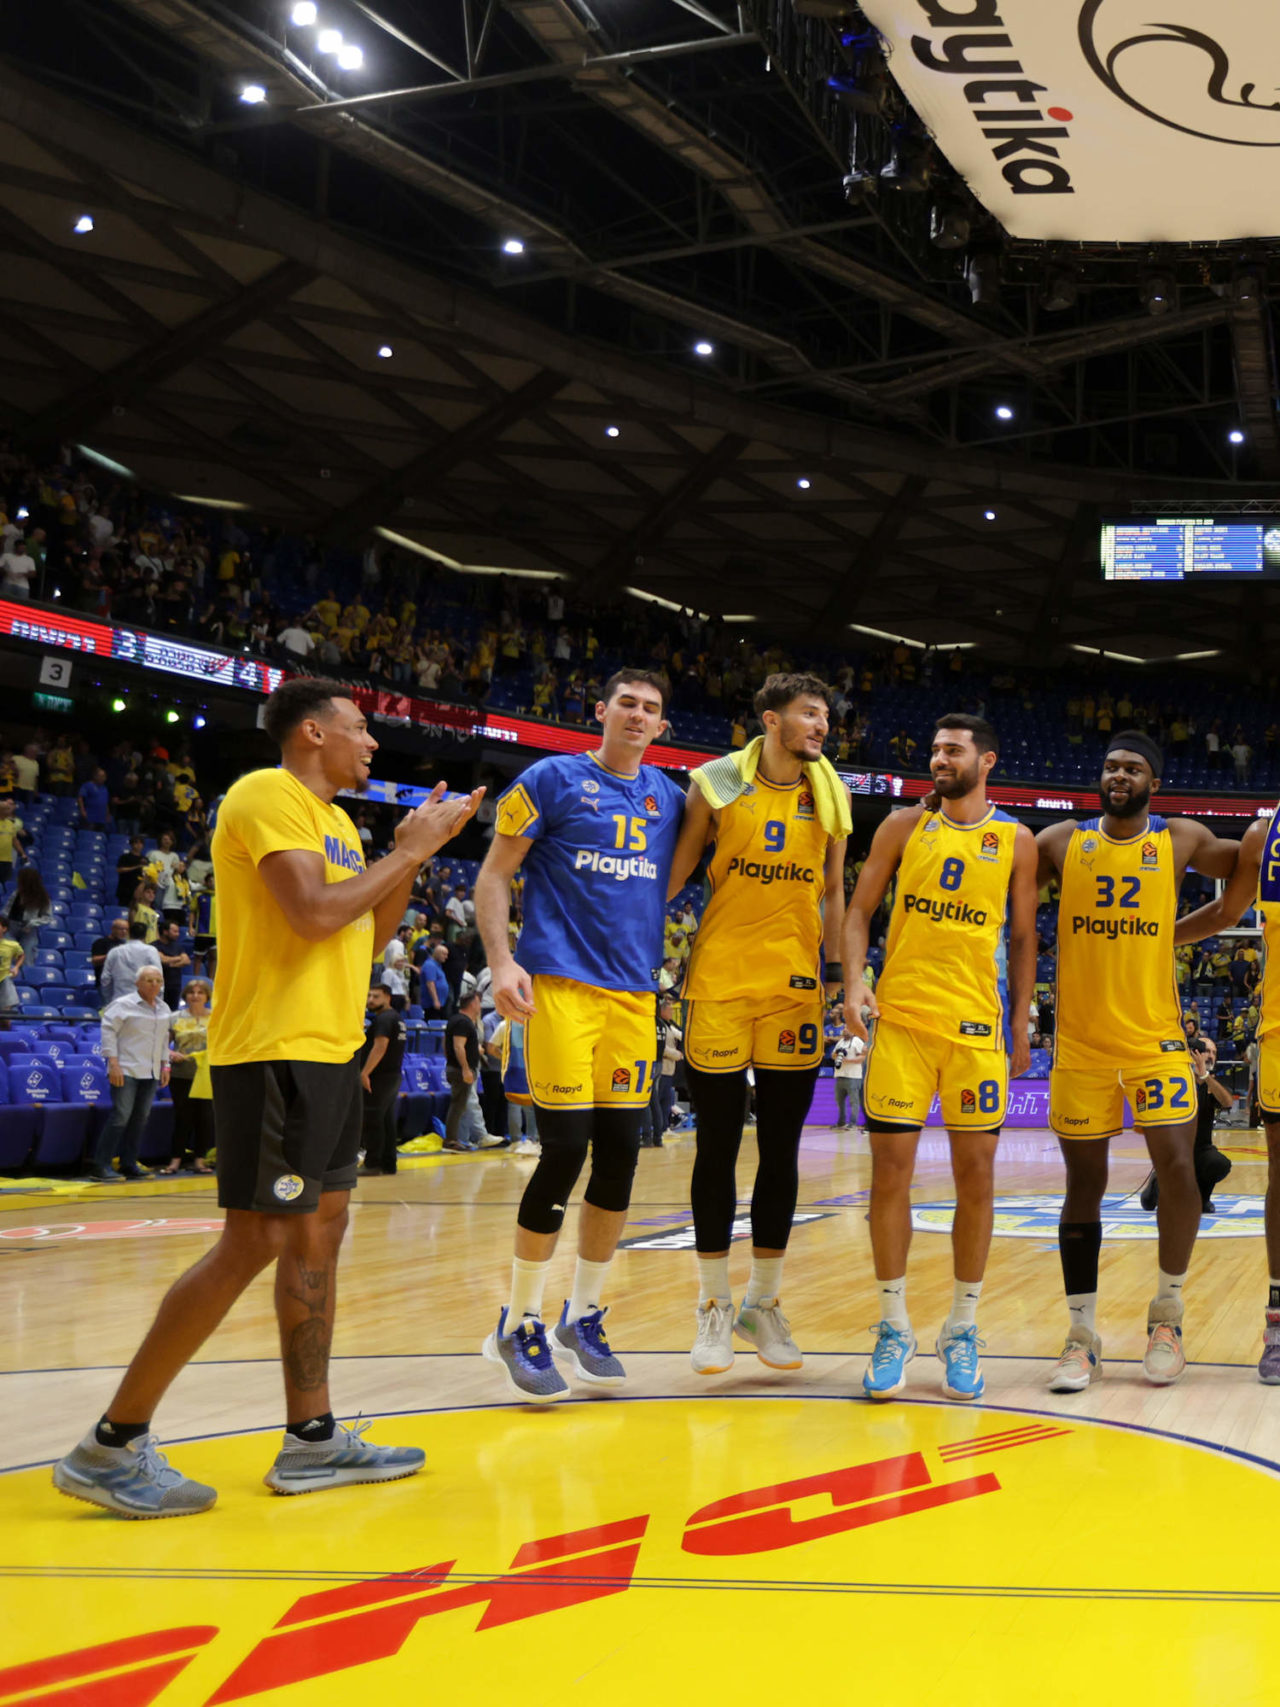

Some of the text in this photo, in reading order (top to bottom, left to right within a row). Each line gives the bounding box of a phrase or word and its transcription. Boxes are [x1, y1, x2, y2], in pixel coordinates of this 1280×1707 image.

[117, 631, 137, 658] 3
[49, 663, 63, 681] 3
[239, 661, 258, 686] 4
[612, 814, 648, 851] 15
[764, 819, 786, 853] 9
[574, 850, 658, 882] Playtika
[939, 856, 966, 892] 8
[1095, 875, 1142, 908] 32
[1072, 914, 1160, 940] Playtika
[712, 1047, 739, 1059] Rapyd
[798, 1023, 818, 1055] 9
[552, 1083, 583, 1095] Rapyd
[888, 1097, 915, 1110] Rapyd
[978, 1079, 1000, 1114] 8
[1144, 1076, 1190, 1110] 32
[1063, 1115, 1090, 1127] Rapyd
